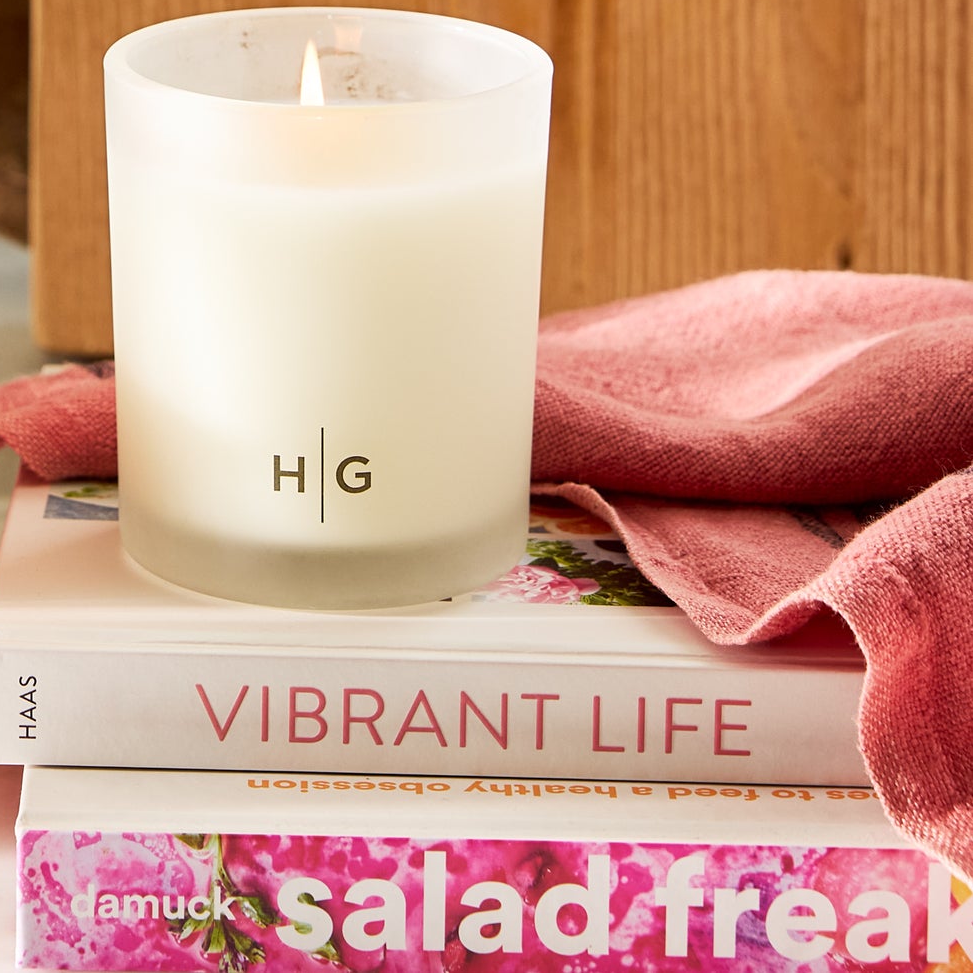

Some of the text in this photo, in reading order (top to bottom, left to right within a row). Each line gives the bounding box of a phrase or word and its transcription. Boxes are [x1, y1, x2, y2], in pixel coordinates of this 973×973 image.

[18, 675, 37, 740] HAAS
[195, 683, 752, 757] VIBRANT LIFE
[247, 778, 451, 795] obsession
[463, 780, 618, 799] healthy
[631, 785, 653, 797] a
[667, 786, 760, 802] feed
[771, 789, 815, 802] to
[70, 883, 236, 921] damuck
[275, 850, 973, 964] salad freak
